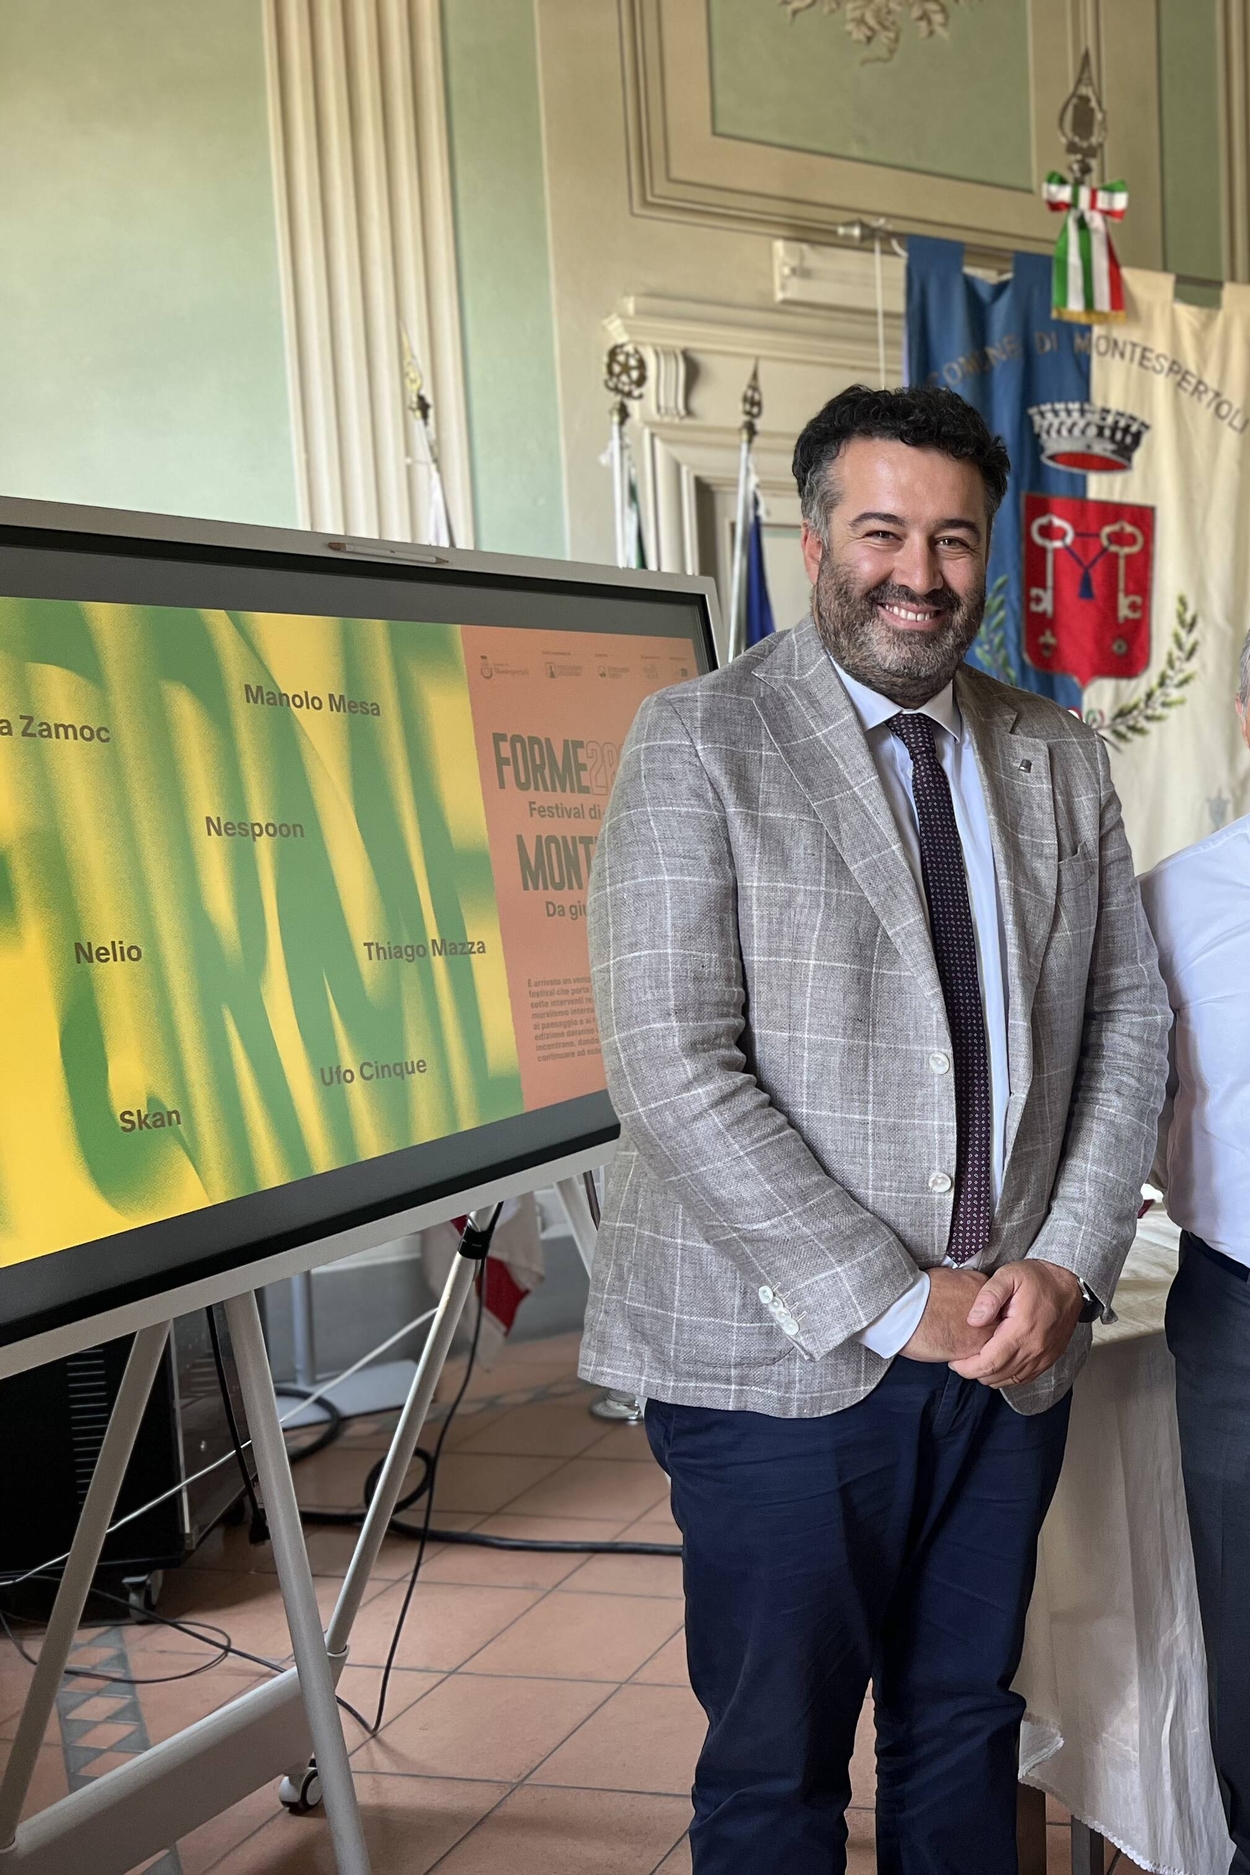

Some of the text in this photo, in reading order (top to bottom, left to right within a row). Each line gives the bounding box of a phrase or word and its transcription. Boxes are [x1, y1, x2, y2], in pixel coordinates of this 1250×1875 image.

[1034, 331, 1059, 355] DI
[1074, 331, 1250, 434] MONTESPERTOLI
[244, 684, 381, 716] Manolo Mesa
[19, 714, 111, 743] Zamoc
[529, 801, 601, 819] Festival di
[205, 816, 305, 842] Nespoon
[516, 834, 598, 891] MONT
[545, 901, 566, 917] Da
[74, 940, 143, 964] Nelio
[363, 938, 486, 962] Thiago Mazza
[320, 1059, 427, 1086] Ufo Cinque
[119, 1109, 182, 1133] Skan
